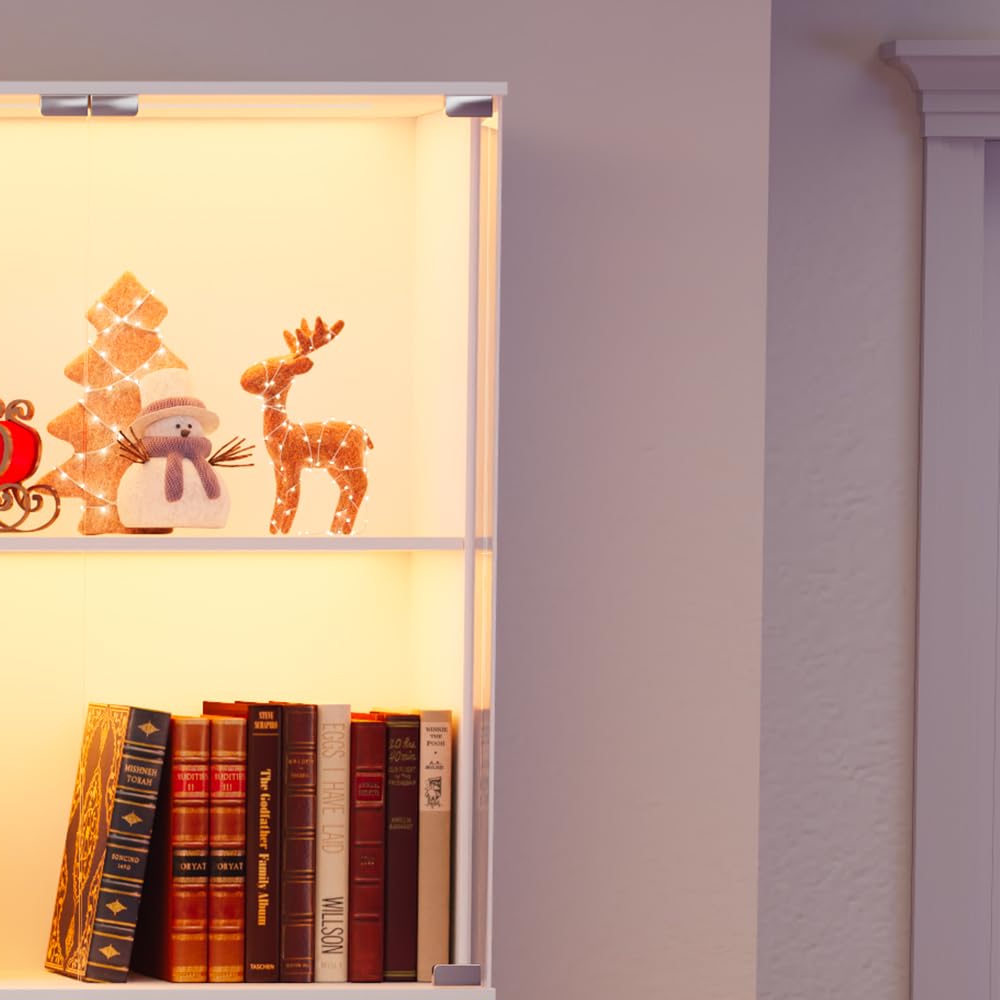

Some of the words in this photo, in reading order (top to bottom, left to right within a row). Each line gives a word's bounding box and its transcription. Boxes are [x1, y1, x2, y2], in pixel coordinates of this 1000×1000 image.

[321, 722, 346, 758] EGGS
[124, 763, 158, 777] MISHNEH
[126, 774, 153, 787] TORAH
[260, 768, 272, 790] The
[321, 781, 346, 816] HAVE
[259, 793, 272, 850] Godfather
[257, 853, 270, 889] Family
[257, 892, 269, 926] Album
[320, 895, 345, 955] WILLSON
[249, 962, 276, 971] TASCHEN
